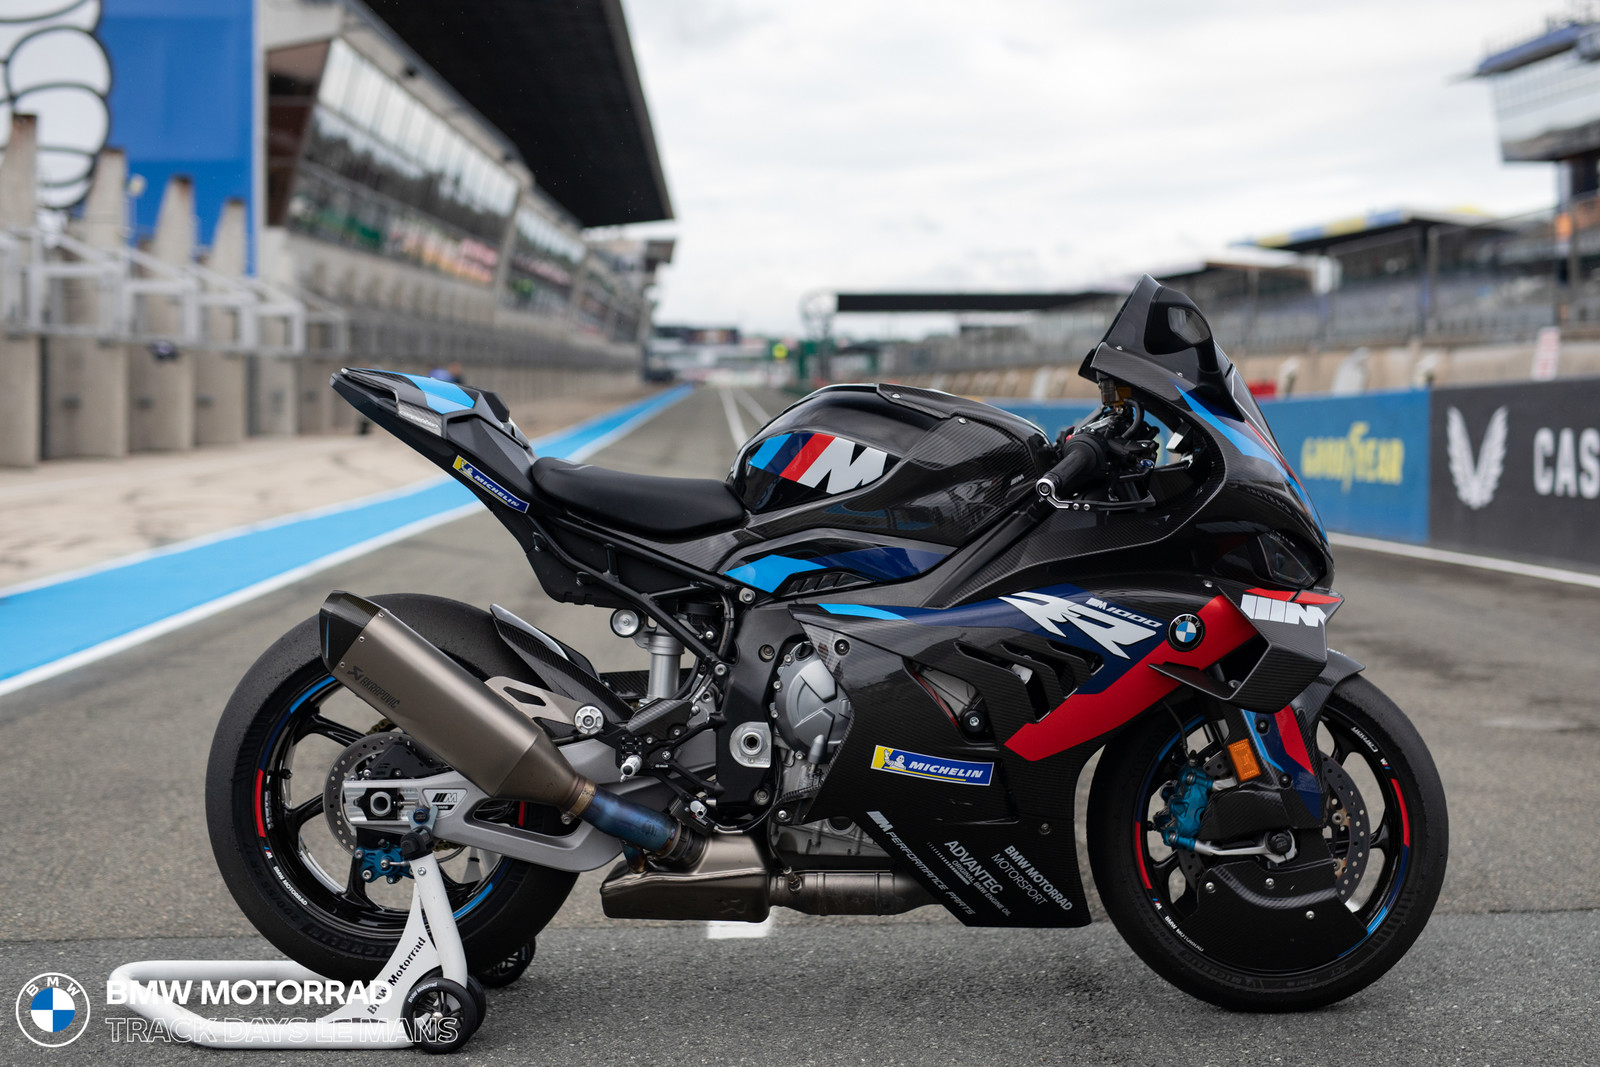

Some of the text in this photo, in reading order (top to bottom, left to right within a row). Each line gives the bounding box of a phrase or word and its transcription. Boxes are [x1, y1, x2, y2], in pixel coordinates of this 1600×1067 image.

[1533, 427, 1600, 499] CAS
[474, 475, 520, 507] MICHELIN
[1106, 606, 1163, 628] 1000
[1175, 614, 1202, 629] BMW
[908, 761, 984, 778] MICHELIN
[273, 865, 308, 906] BMW MOTORRAD
[886, 831, 949, 891] PERFORMANCE
[945, 891, 976, 915] PARTS
[944, 840, 1004, 894] ADVANTEC
[951, 860, 1012, 917] ORIGINAL BMW ENGINE OIL
[991, 853, 1048, 905] MOTORSPORT
[1004, 845, 1073, 911] BMW MOTORRAD
[1164, 915, 1178, 930] BMW
[387, 936, 427, 986] Motorrad
